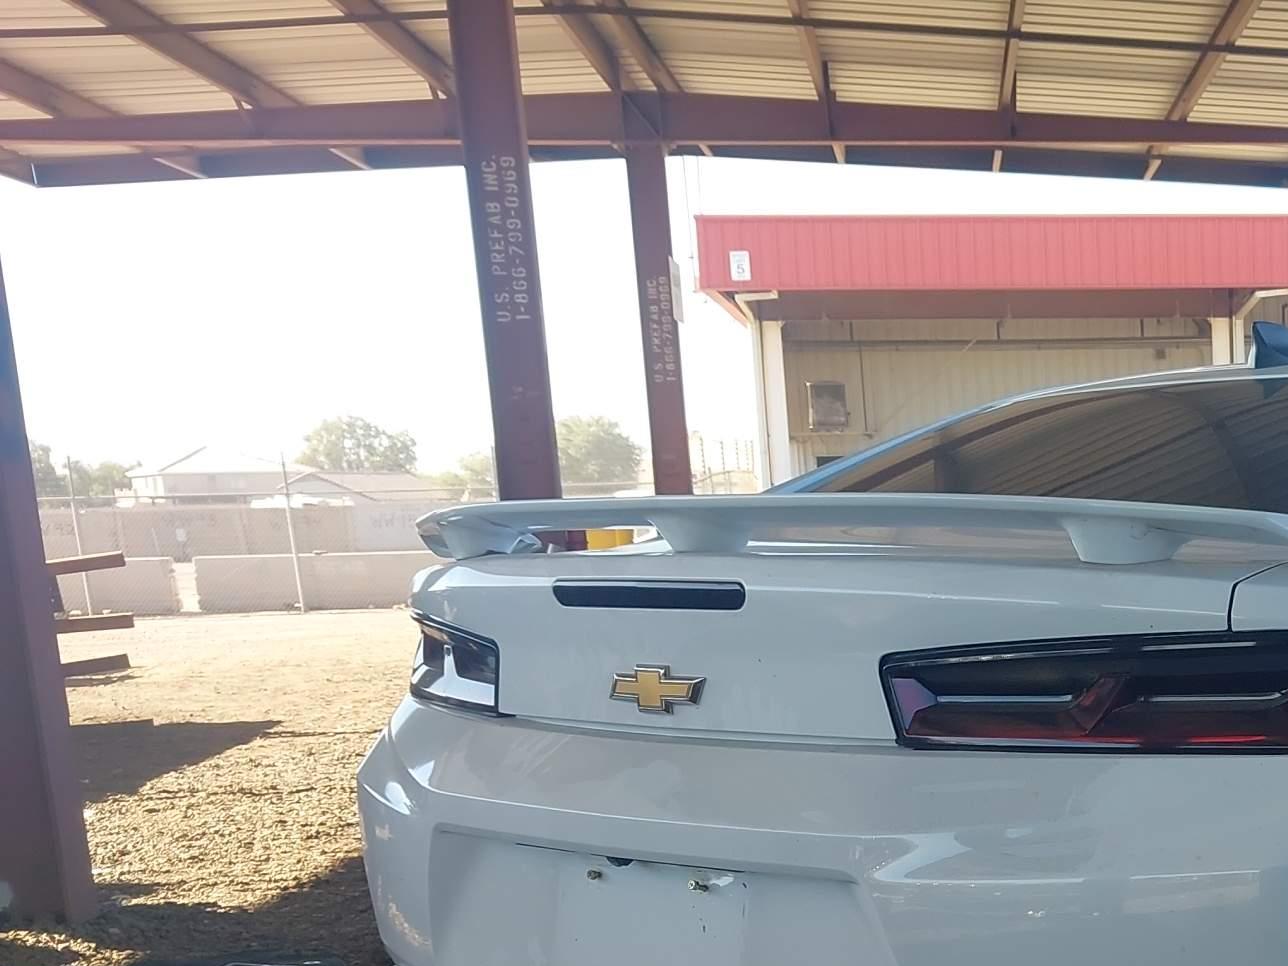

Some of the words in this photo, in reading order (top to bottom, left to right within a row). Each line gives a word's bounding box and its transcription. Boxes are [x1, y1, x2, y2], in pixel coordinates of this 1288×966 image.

[481, 154, 499, 192] INC.
[486, 201, 508, 276] PREFAB
[500, 156, 531, 320] 1-866-799-0969
[736, 263, 745, 274] 5
[495, 286, 512, 322] U.S.
[648, 304, 662, 353] PREFAB
